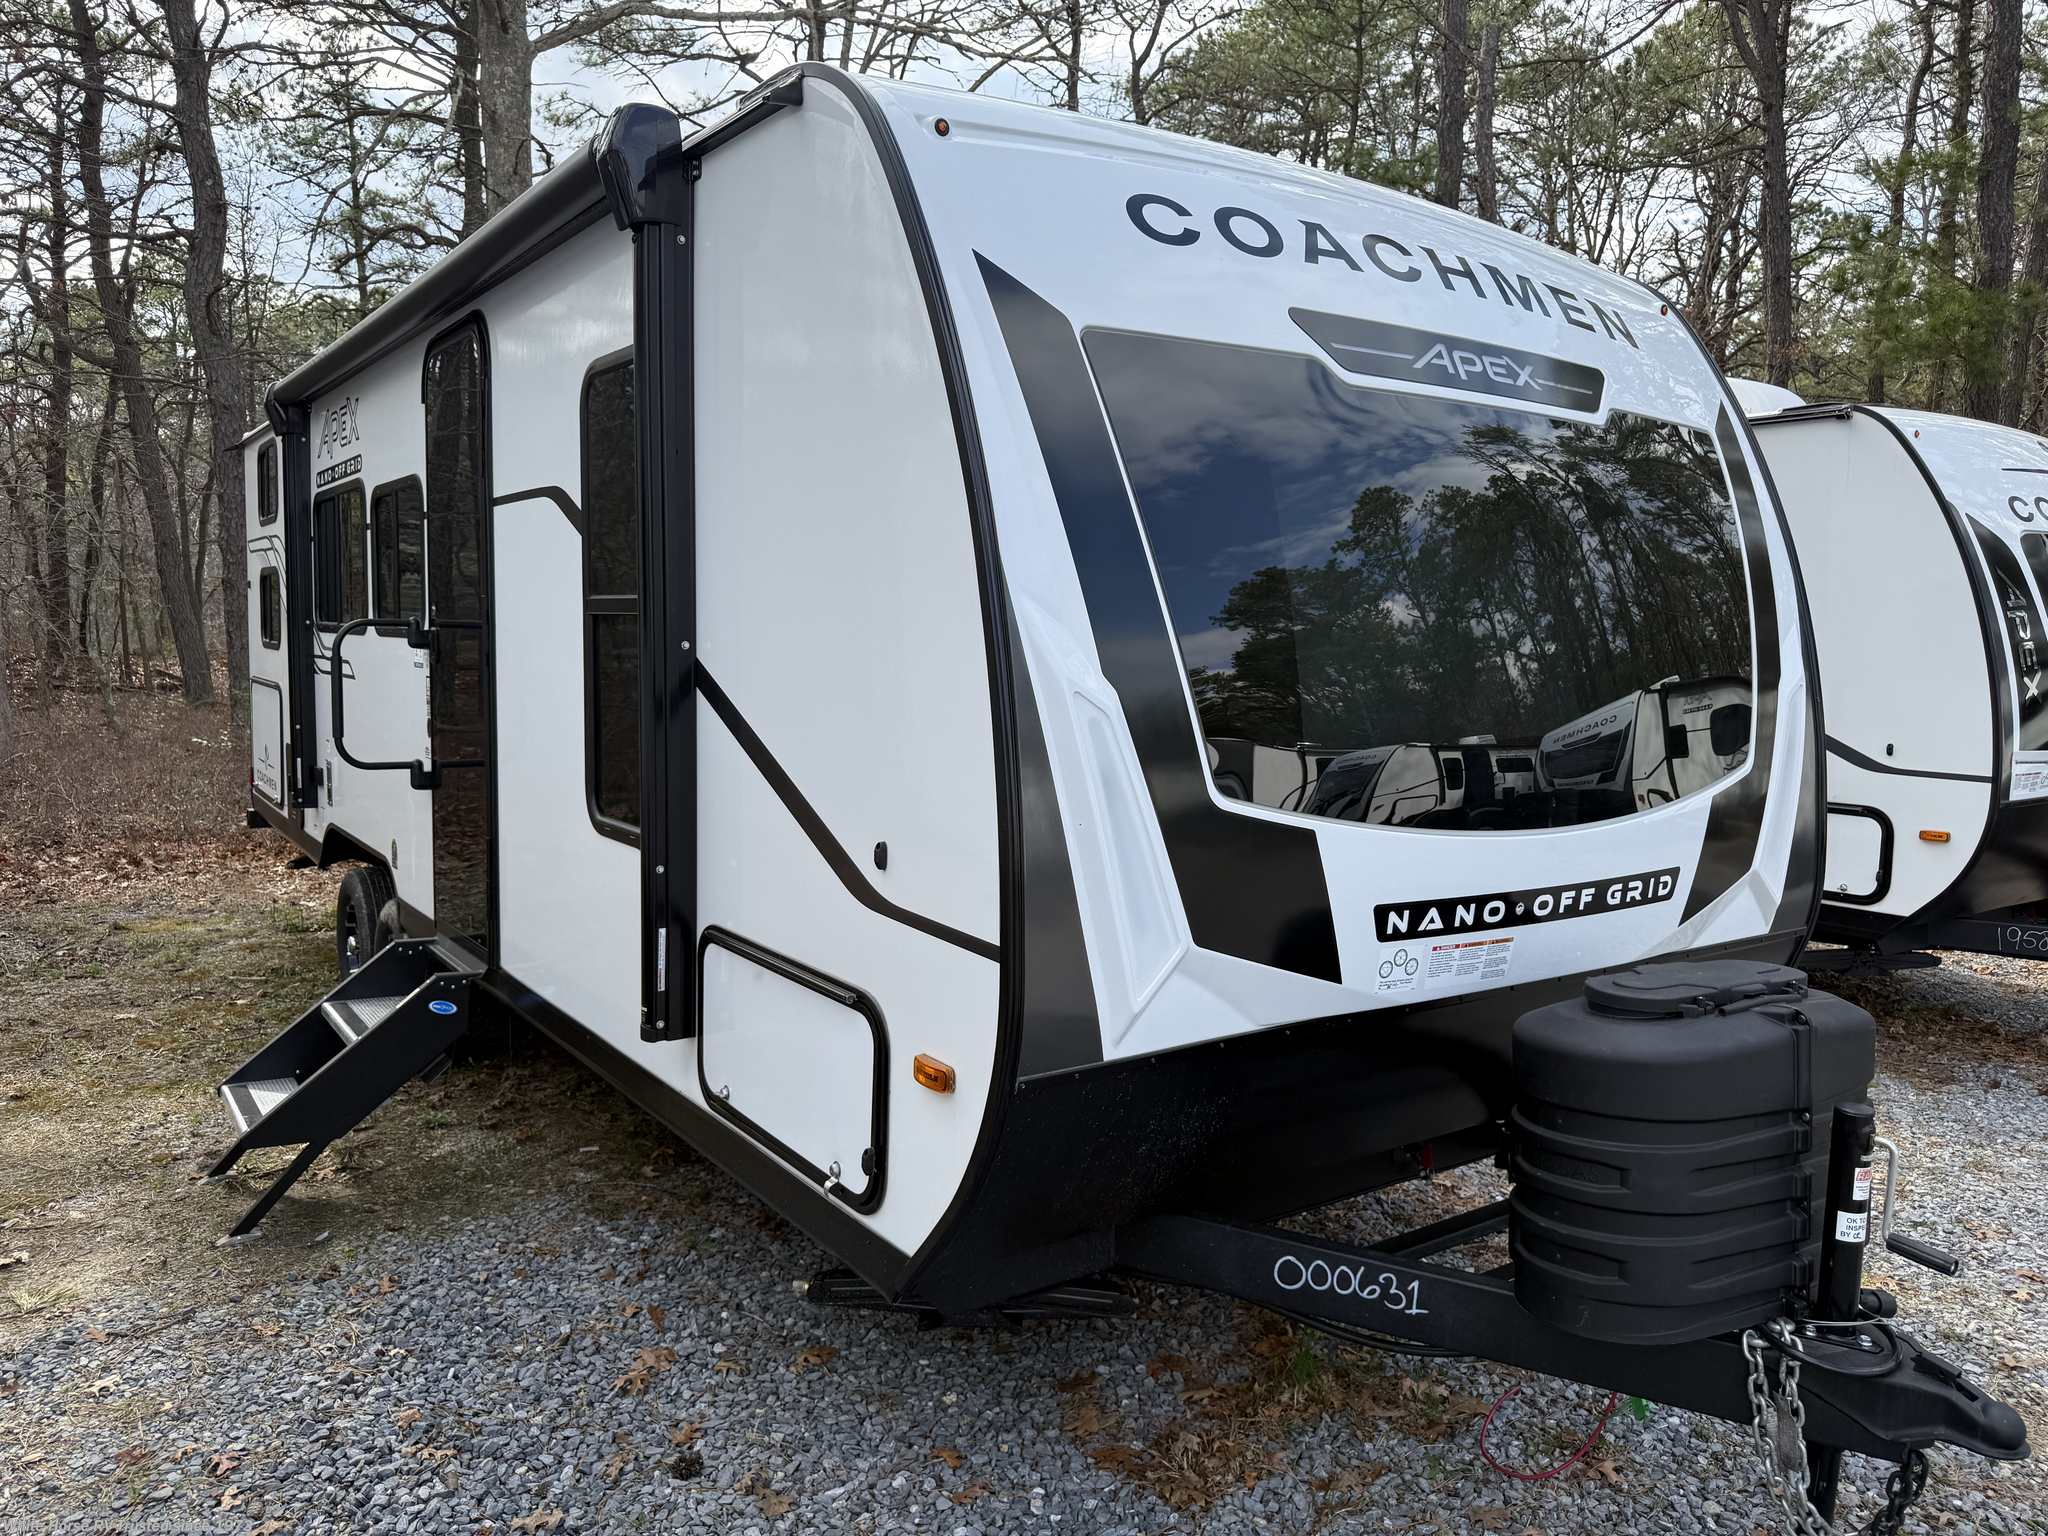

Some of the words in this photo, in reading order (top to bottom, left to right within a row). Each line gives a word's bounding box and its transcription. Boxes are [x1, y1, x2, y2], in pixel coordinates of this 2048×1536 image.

[1125, 193, 1640, 350] COACHMEN
[1411, 342, 1543, 391] APEX
[317, 396, 360, 460] APEX
[335, 464, 345, 478] OFF
[347, 457, 361, 473] GRID
[1995, 565, 2042, 706] APEX
[1386, 900, 1506, 935] NANO
[1532, 888, 1596, 916] OFF
[1606, 875, 1673, 906] GRID
[1555, 1157, 1599, 1184] GAS
[1840, 1230, 1851, 1238] BY
[1273, 1255, 1430, 1316] 000631
